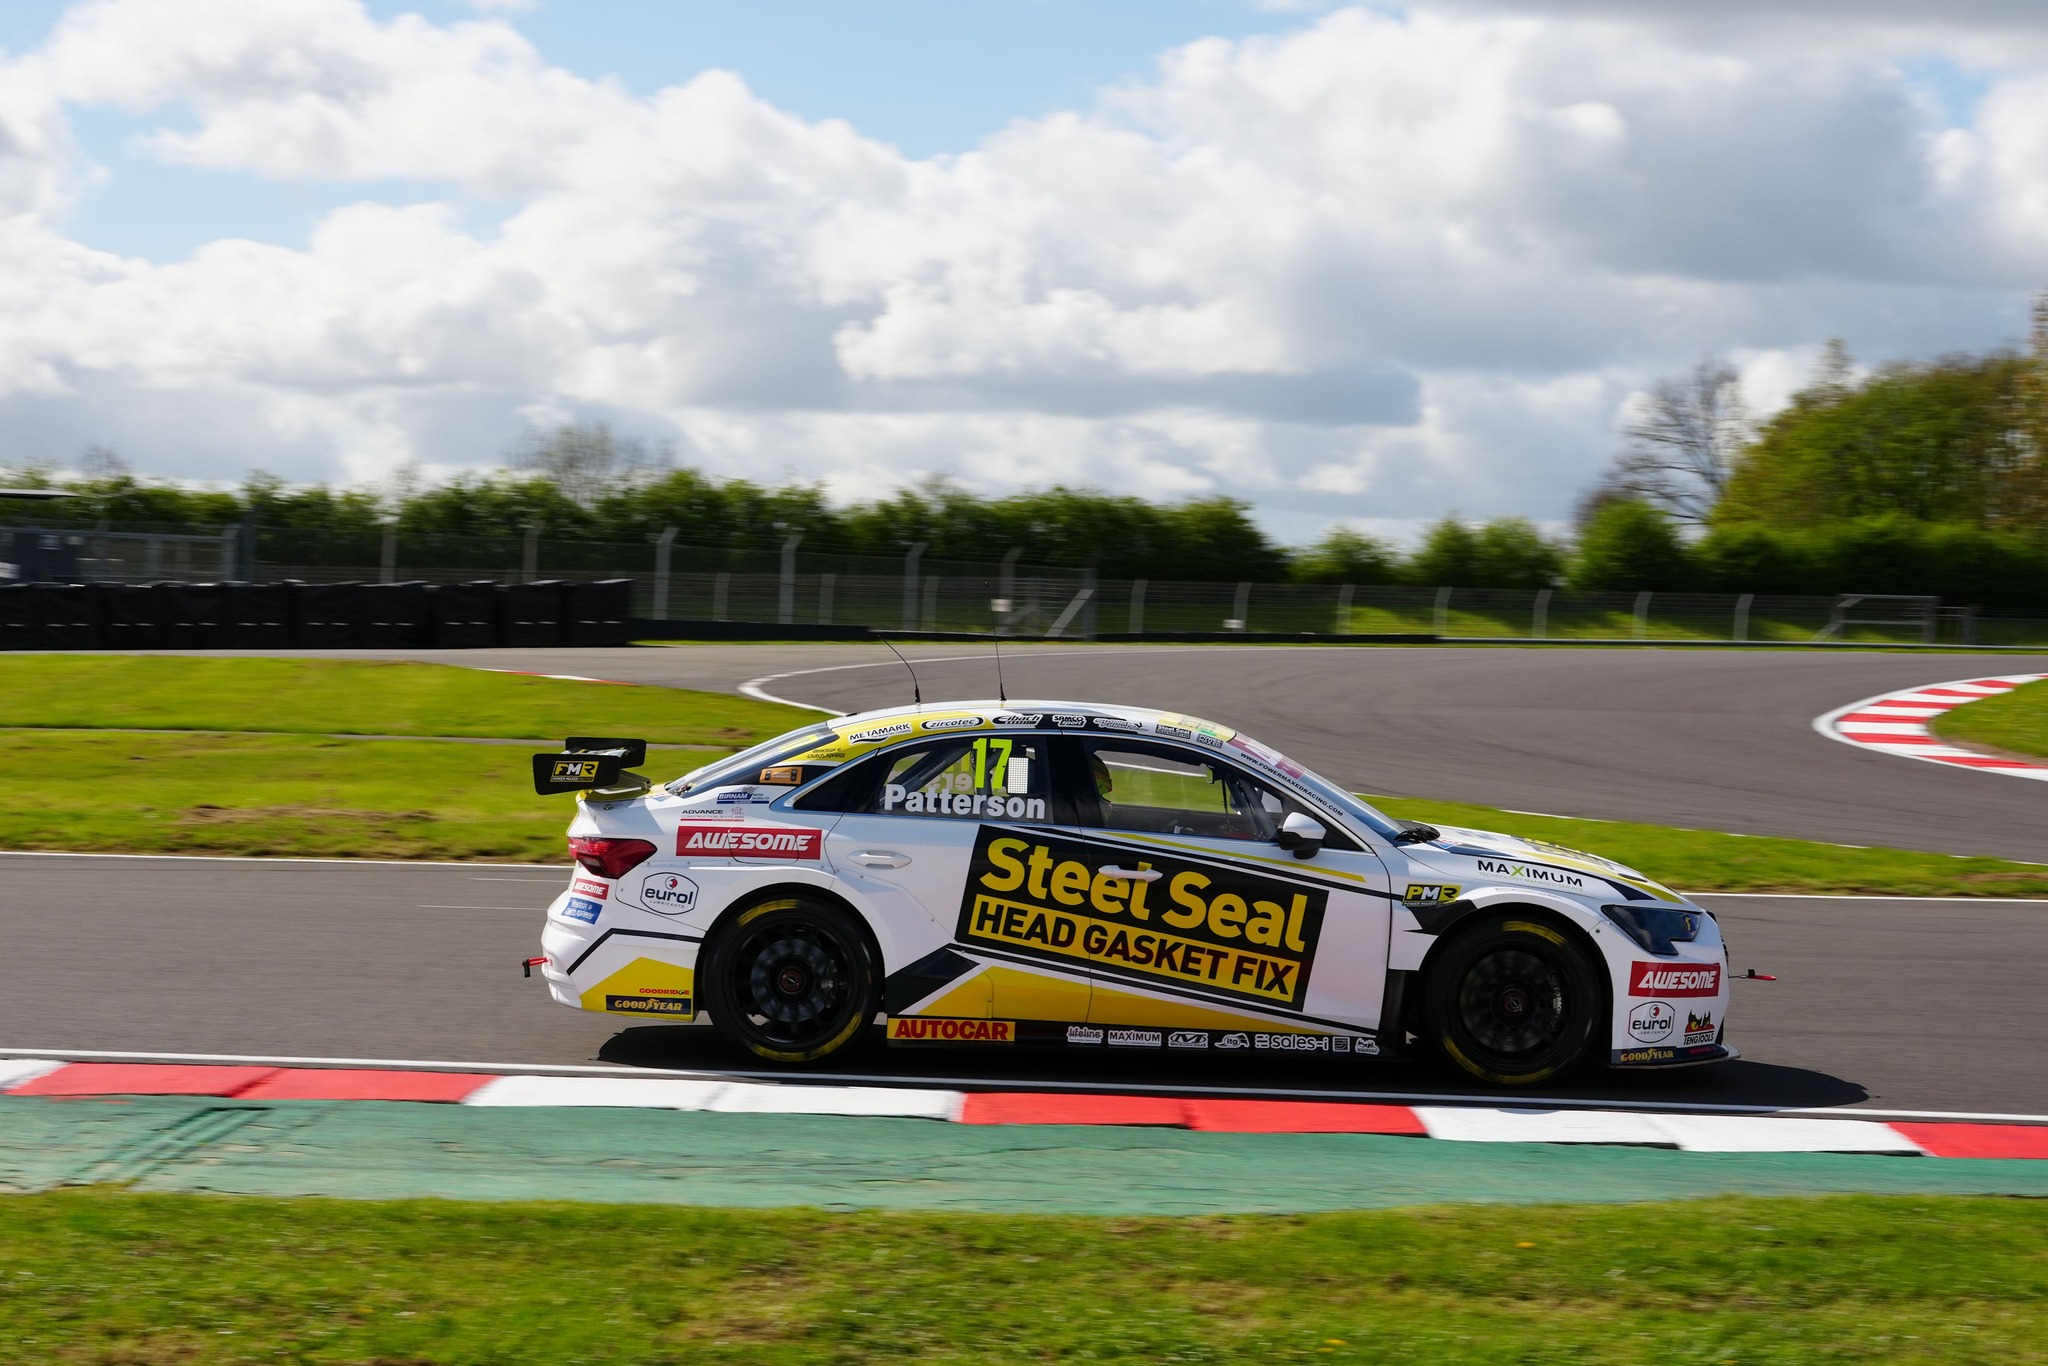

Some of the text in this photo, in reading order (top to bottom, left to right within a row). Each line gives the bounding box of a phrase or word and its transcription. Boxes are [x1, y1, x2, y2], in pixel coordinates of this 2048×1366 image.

[850, 723, 910, 741] METAMARK
[930, 719, 976, 728] zircotec
[973, 738, 1013, 789] 17
[1240, 752, 1344, 817] WWW.POWERMAXEDRACING.COM
[884, 783, 1046, 820] Patterson
[685, 832, 813, 851] AWESOME
[1477, 860, 1584, 887] MAXIMUM
[645, 887, 693, 905] eurol
[979, 837, 1308, 952] Steel Seal
[1406, 886, 1458, 900] PMR
[649, 899, 685, 909] LUBRICANTS
[976, 900, 1295, 996] HEAD GASKET FIX
[1637, 970, 1717, 989] AWESOME
[614, 998, 683, 1011] GOODYEAR
[894, 1020, 1009, 1040] AUTOCAR
[1632, 1015, 1672, 1030] eurol
[1109, 1030, 1160, 1042] MAXIMUM
[1272, 1034, 1330, 1050] sales-i
[1620, 1048, 1674, 1062] GOODYEAR
